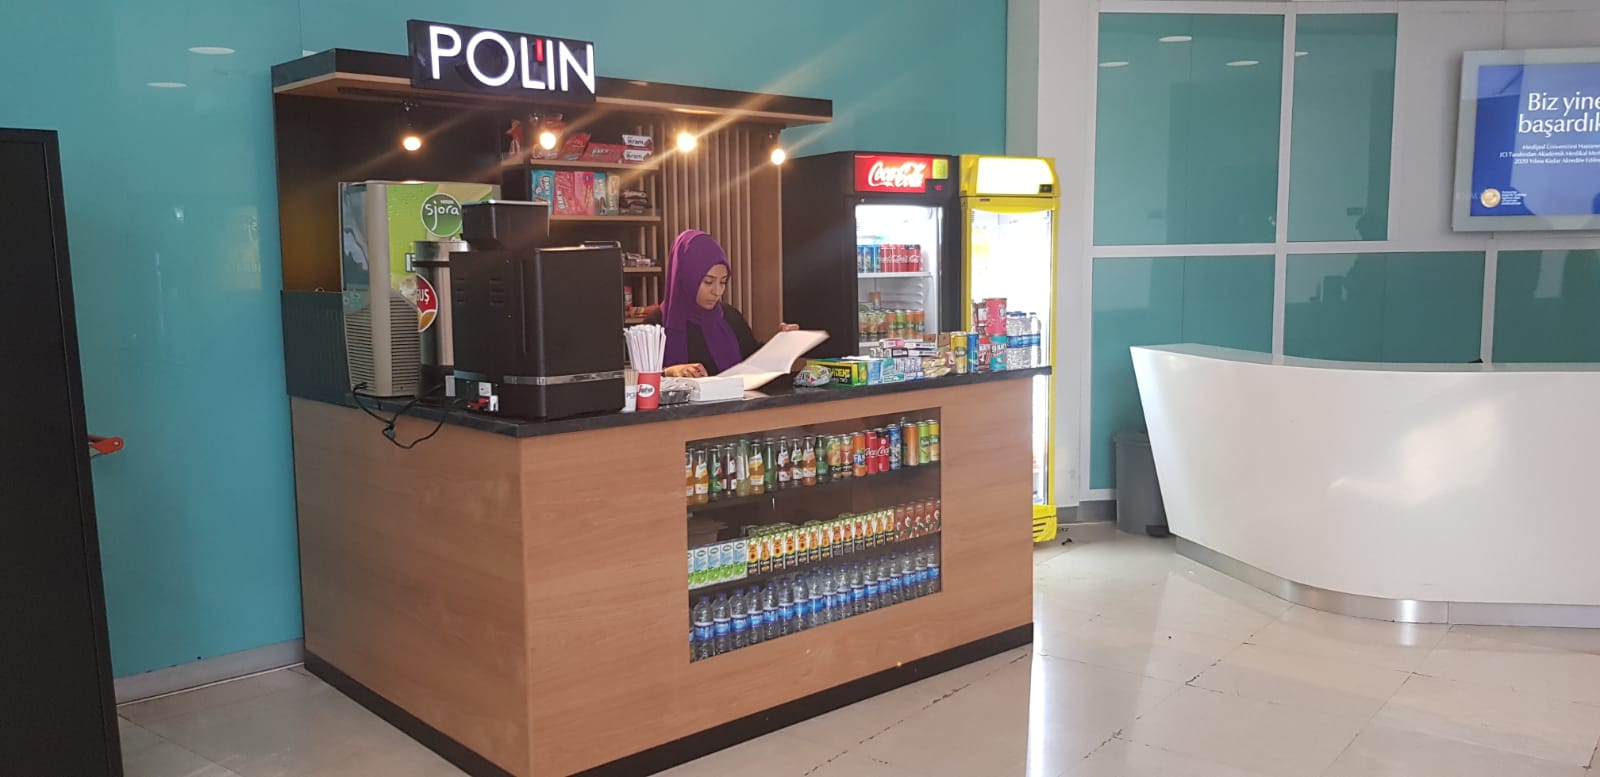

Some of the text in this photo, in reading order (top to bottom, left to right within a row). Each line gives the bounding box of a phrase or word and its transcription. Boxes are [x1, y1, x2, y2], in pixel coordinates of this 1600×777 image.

[1528, 91, 1600, 117] Biz yine
[425, 199, 460, 231] sjora
